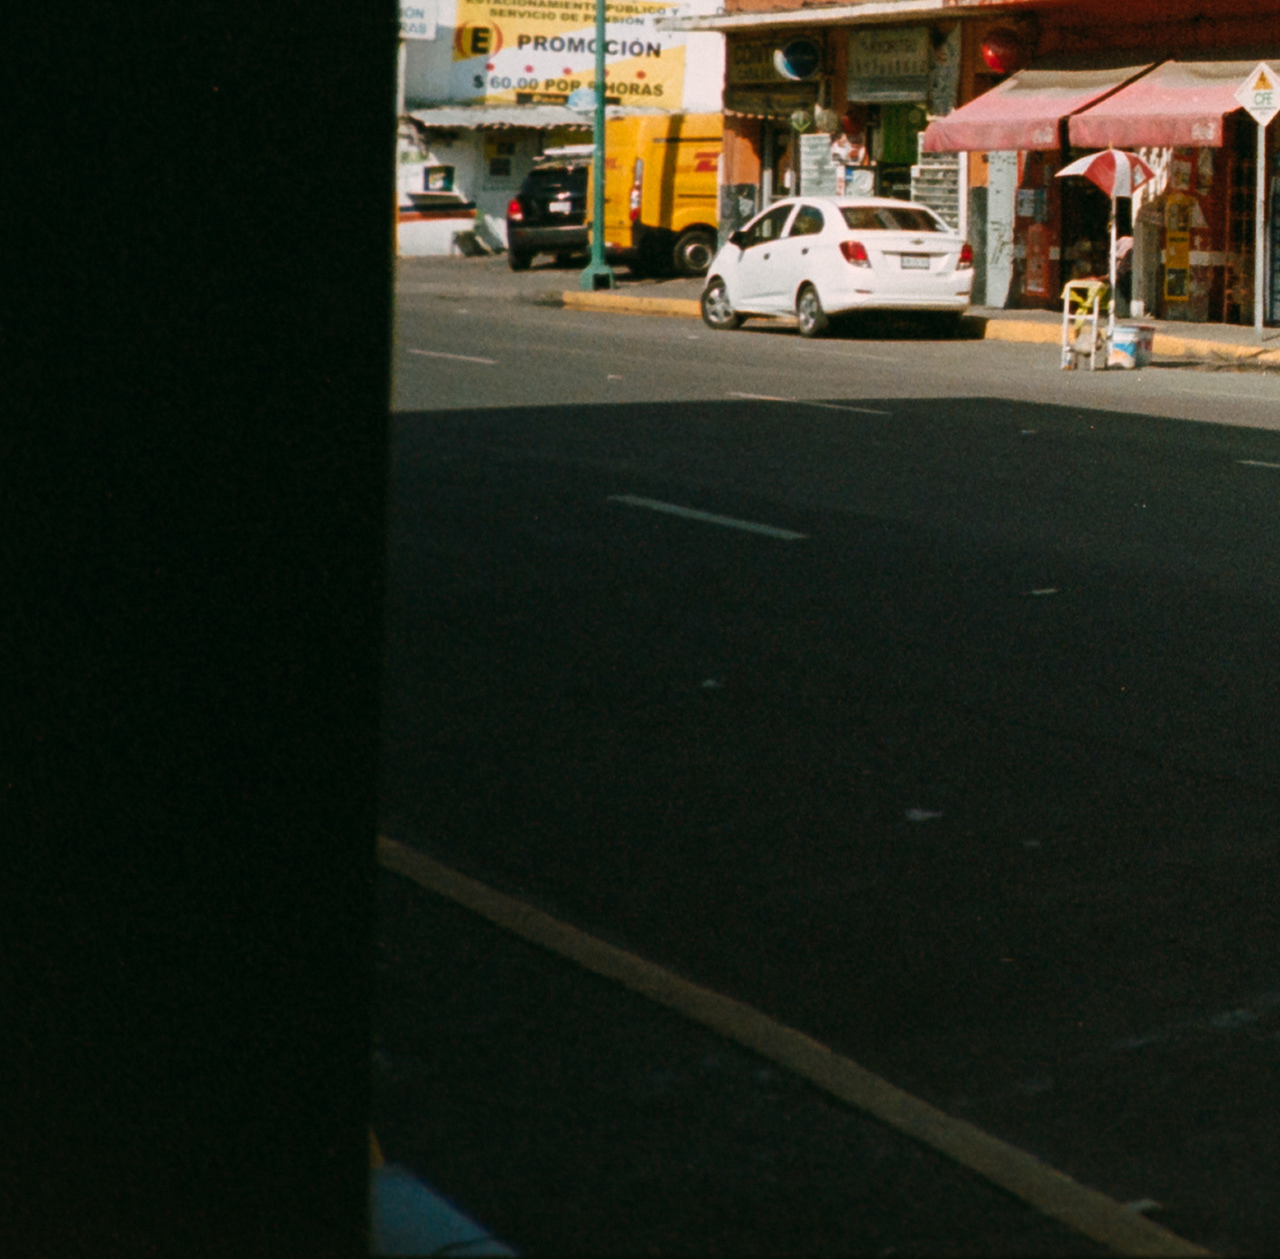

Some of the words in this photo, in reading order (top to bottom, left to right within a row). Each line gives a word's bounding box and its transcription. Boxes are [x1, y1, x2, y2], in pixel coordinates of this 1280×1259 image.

[489, 8, 557, 21] SERVICIO
[560, 13, 579, 22] DE
[471, 27, 490, 54] E
[490, 75, 540, 90] 60.00
[603, 81, 664, 97] HORAS
